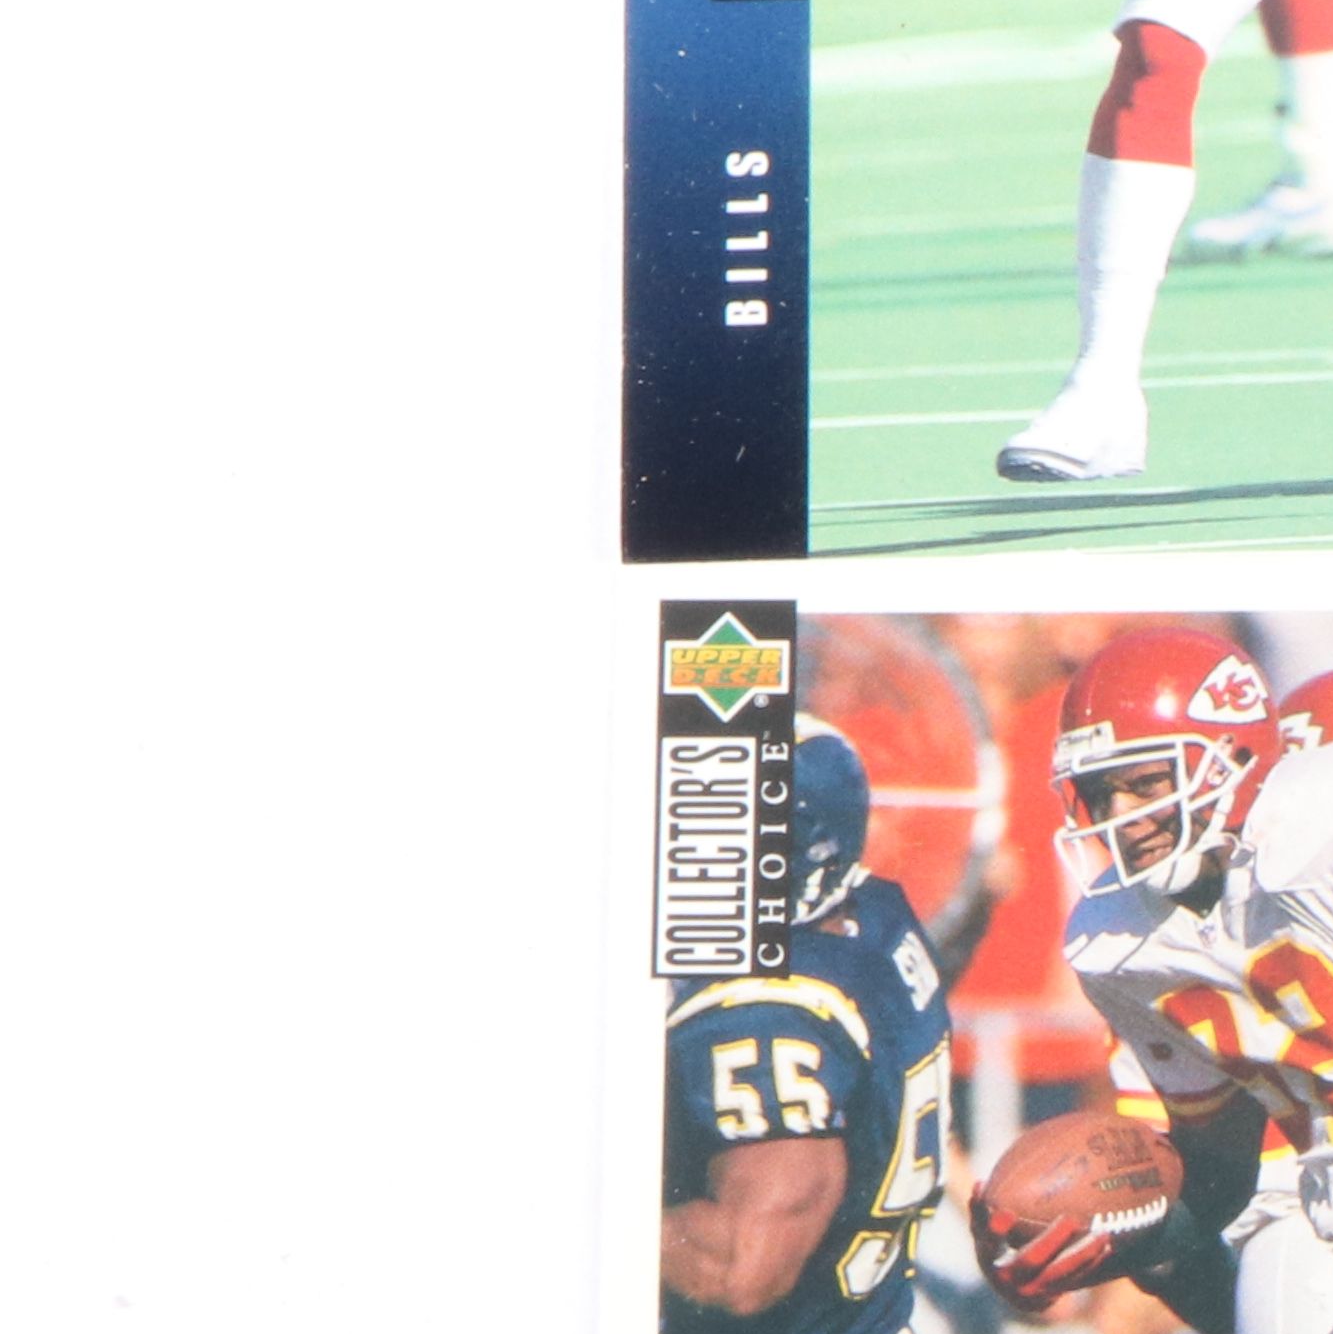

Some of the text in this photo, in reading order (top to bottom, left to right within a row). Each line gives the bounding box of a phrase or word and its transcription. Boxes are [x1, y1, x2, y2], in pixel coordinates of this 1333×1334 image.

[725, 149, 770, 328] BILLS
[670, 647, 783, 666] UPPER
[665, 743, 751, 966] COLLECTOR'S
[756, 741, 790, 968] CHOICE
[711, 1037, 833, 1141] 55
